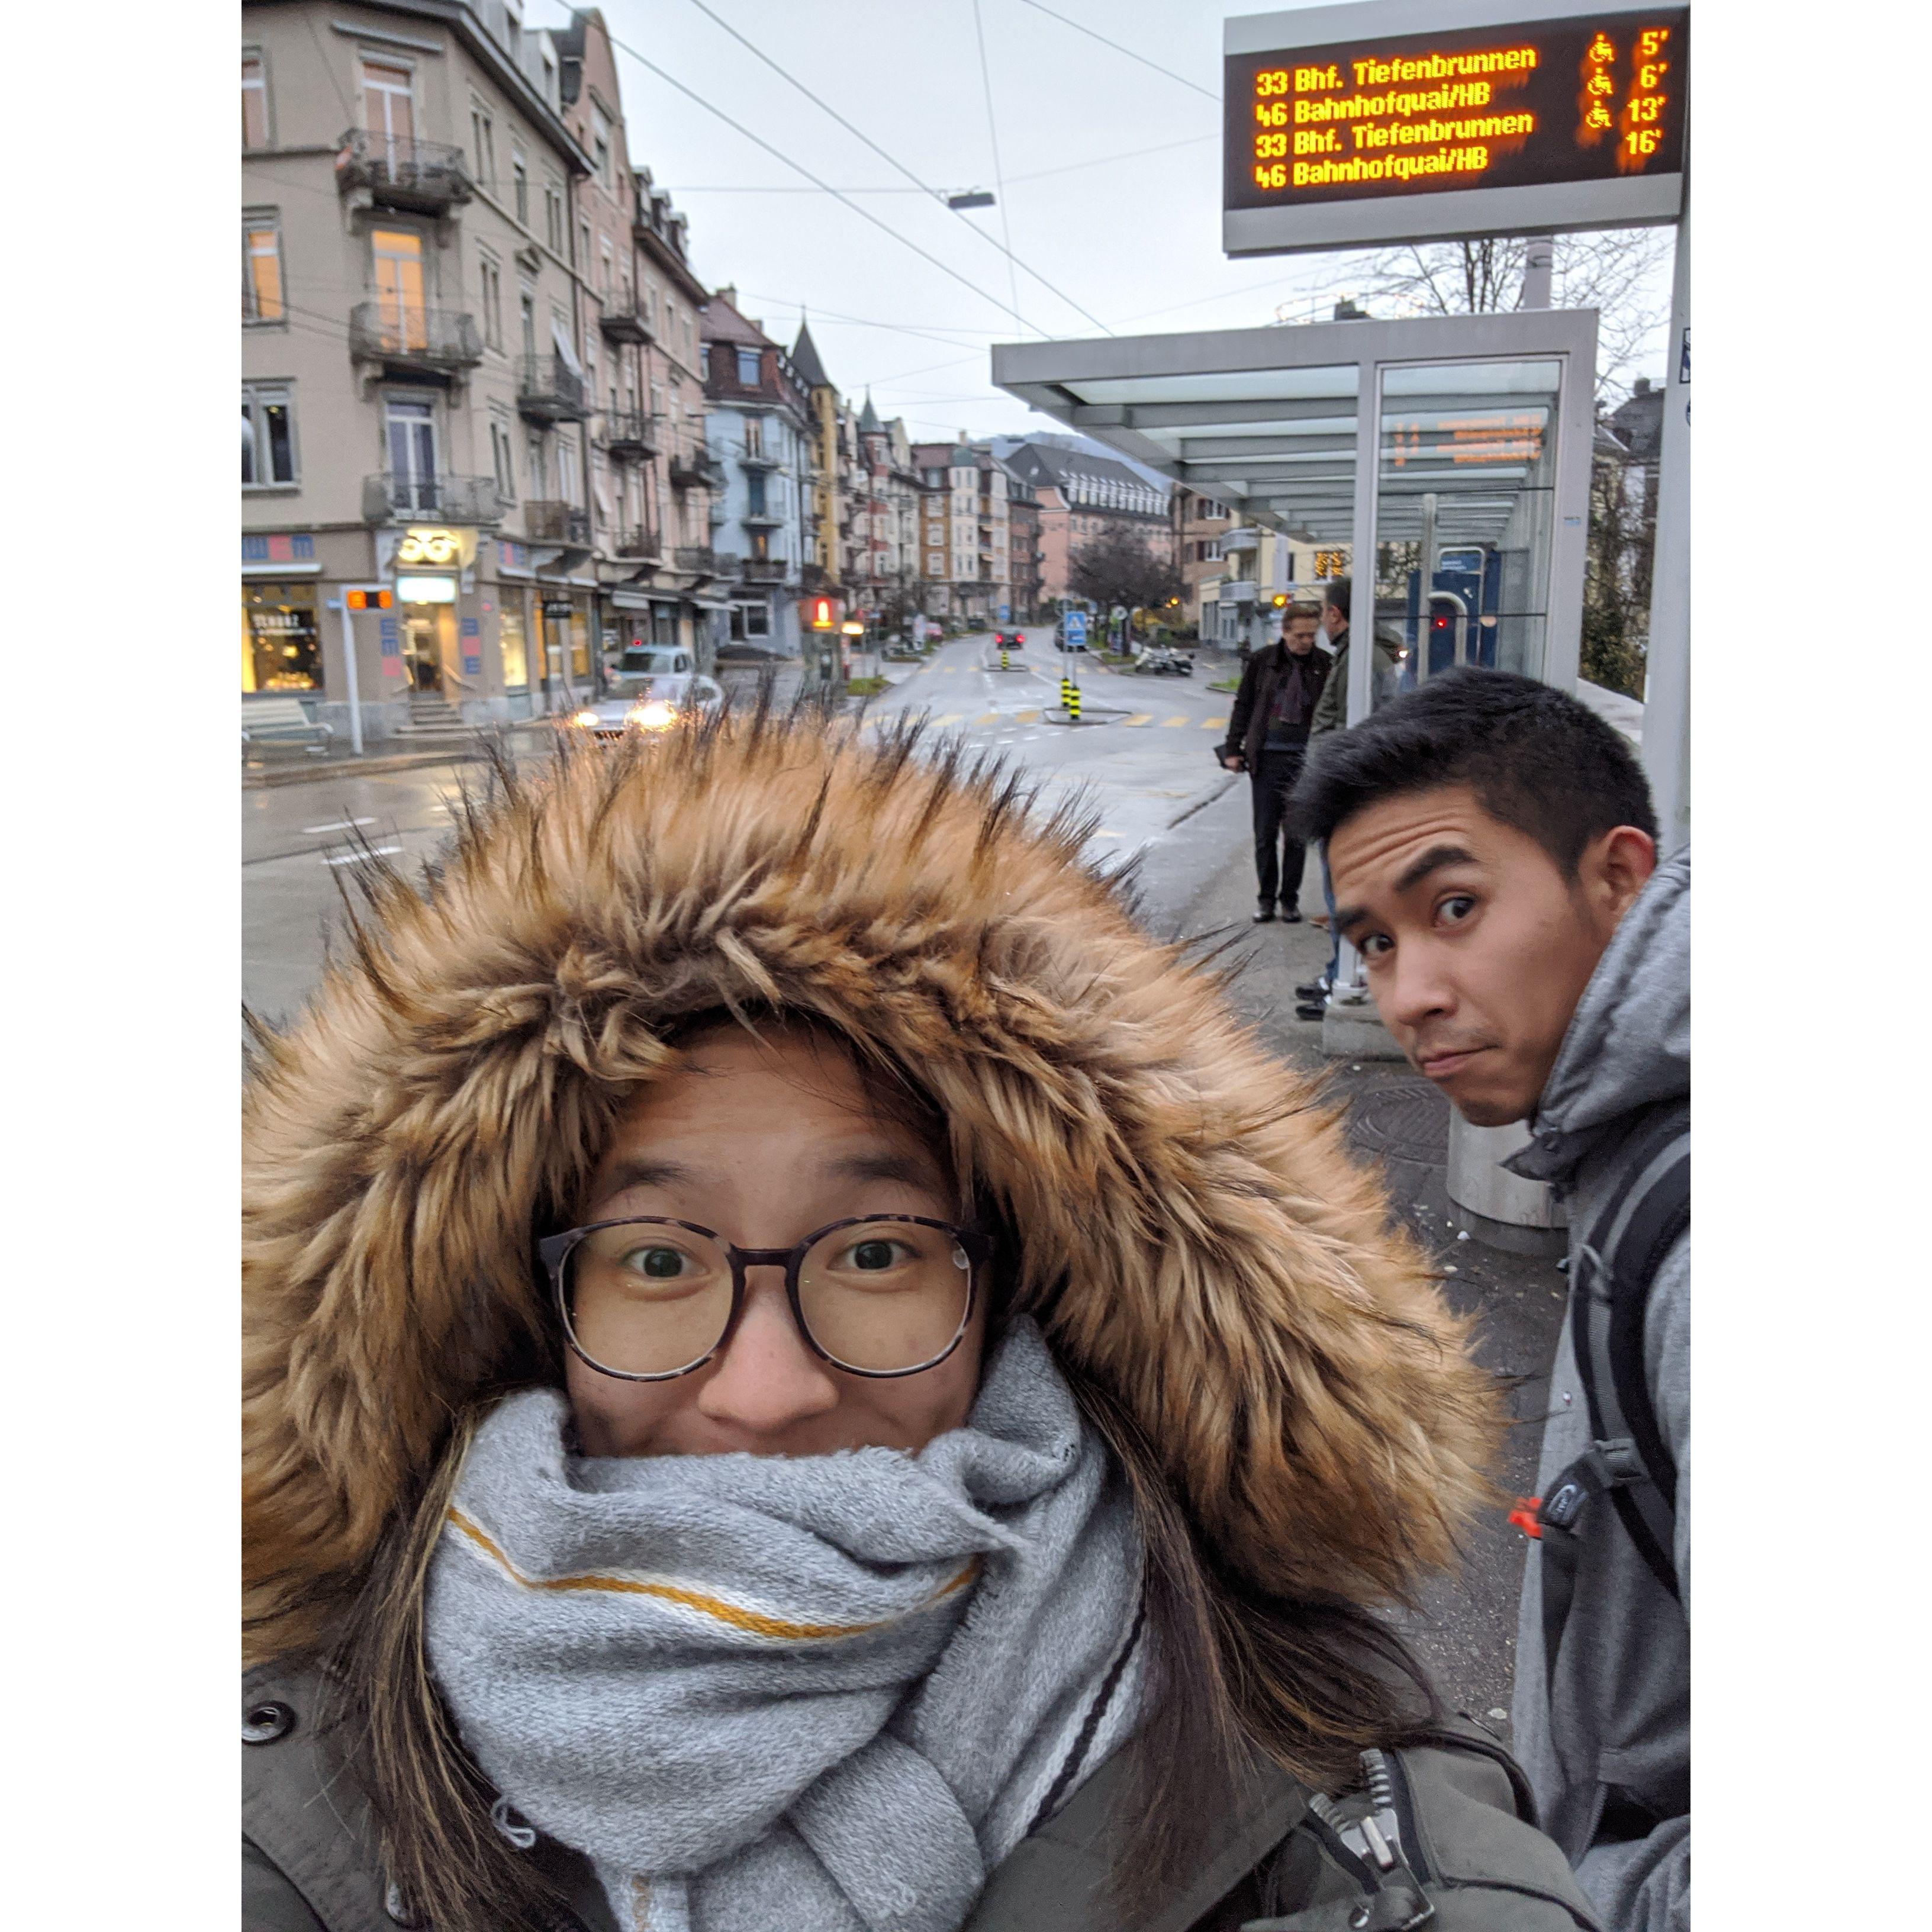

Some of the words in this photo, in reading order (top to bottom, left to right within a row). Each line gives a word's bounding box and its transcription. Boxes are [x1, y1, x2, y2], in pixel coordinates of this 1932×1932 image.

[1256, 71, 1289, 96] 33
[1294, 65, 1344, 92] Bhf.
[1353, 49, 1537, 85] Tiefenbrunnen
[1255, 102, 1288, 127] 46
[1294, 81, 1492, 124] Bahnhofquai/HB
[1255, 133, 1287, 158] 33
[1293, 128, 1342, 155] Bhf.
[1351, 114, 1534, 149] Tiefenbrunnen
[1255, 164, 1287, 188] 46
[1293, 146, 1489, 185] Bahnhofquai/HB
